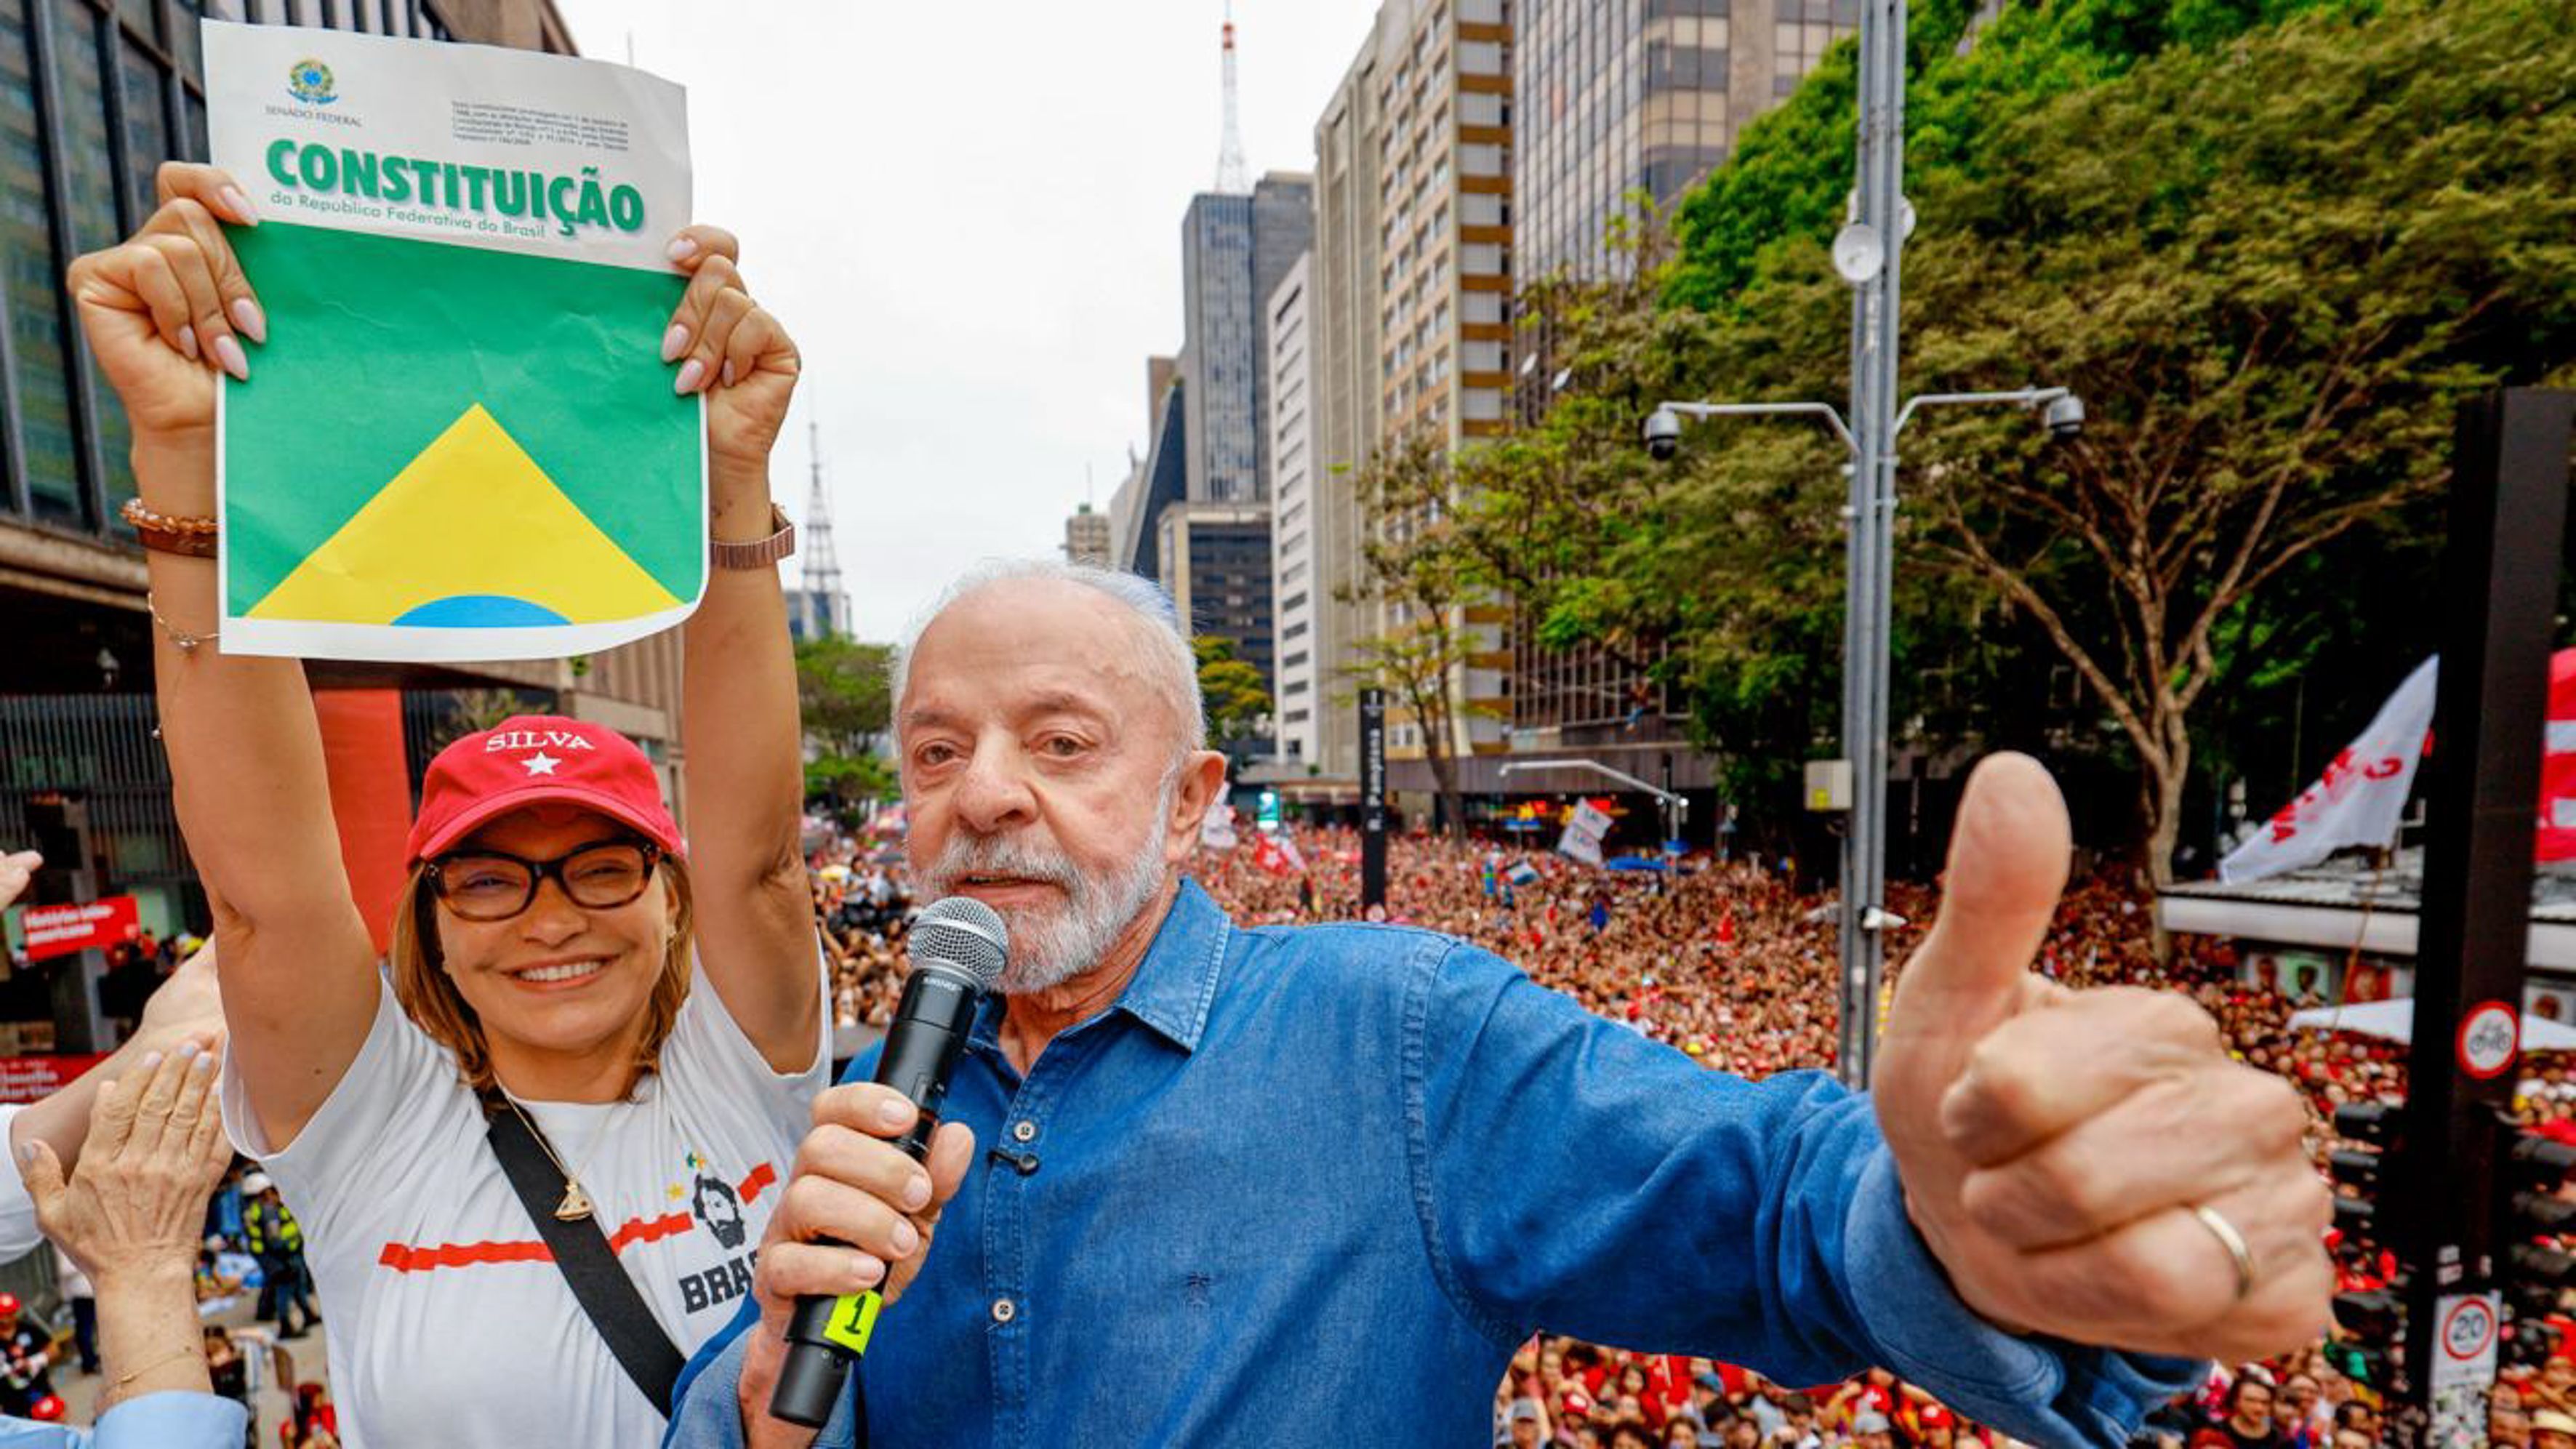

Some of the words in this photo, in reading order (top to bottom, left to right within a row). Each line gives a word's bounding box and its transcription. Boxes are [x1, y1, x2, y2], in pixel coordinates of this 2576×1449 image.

[265, 106, 313, 120] SENADO
[316, 109, 363, 127] FEDERAL
[266, 138, 645, 236] CONSTITUIÇÃO
[270, 191, 292, 206] da
[387, 206, 472, 230] Federativa
[478, 220, 498, 233] do
[502, 221, 545, 239] Brasil
[485, 731, 595, 752] SILVA
[844, 1293, 867, 1335] 1
[2452, 1313, 2485, 1341] 20
